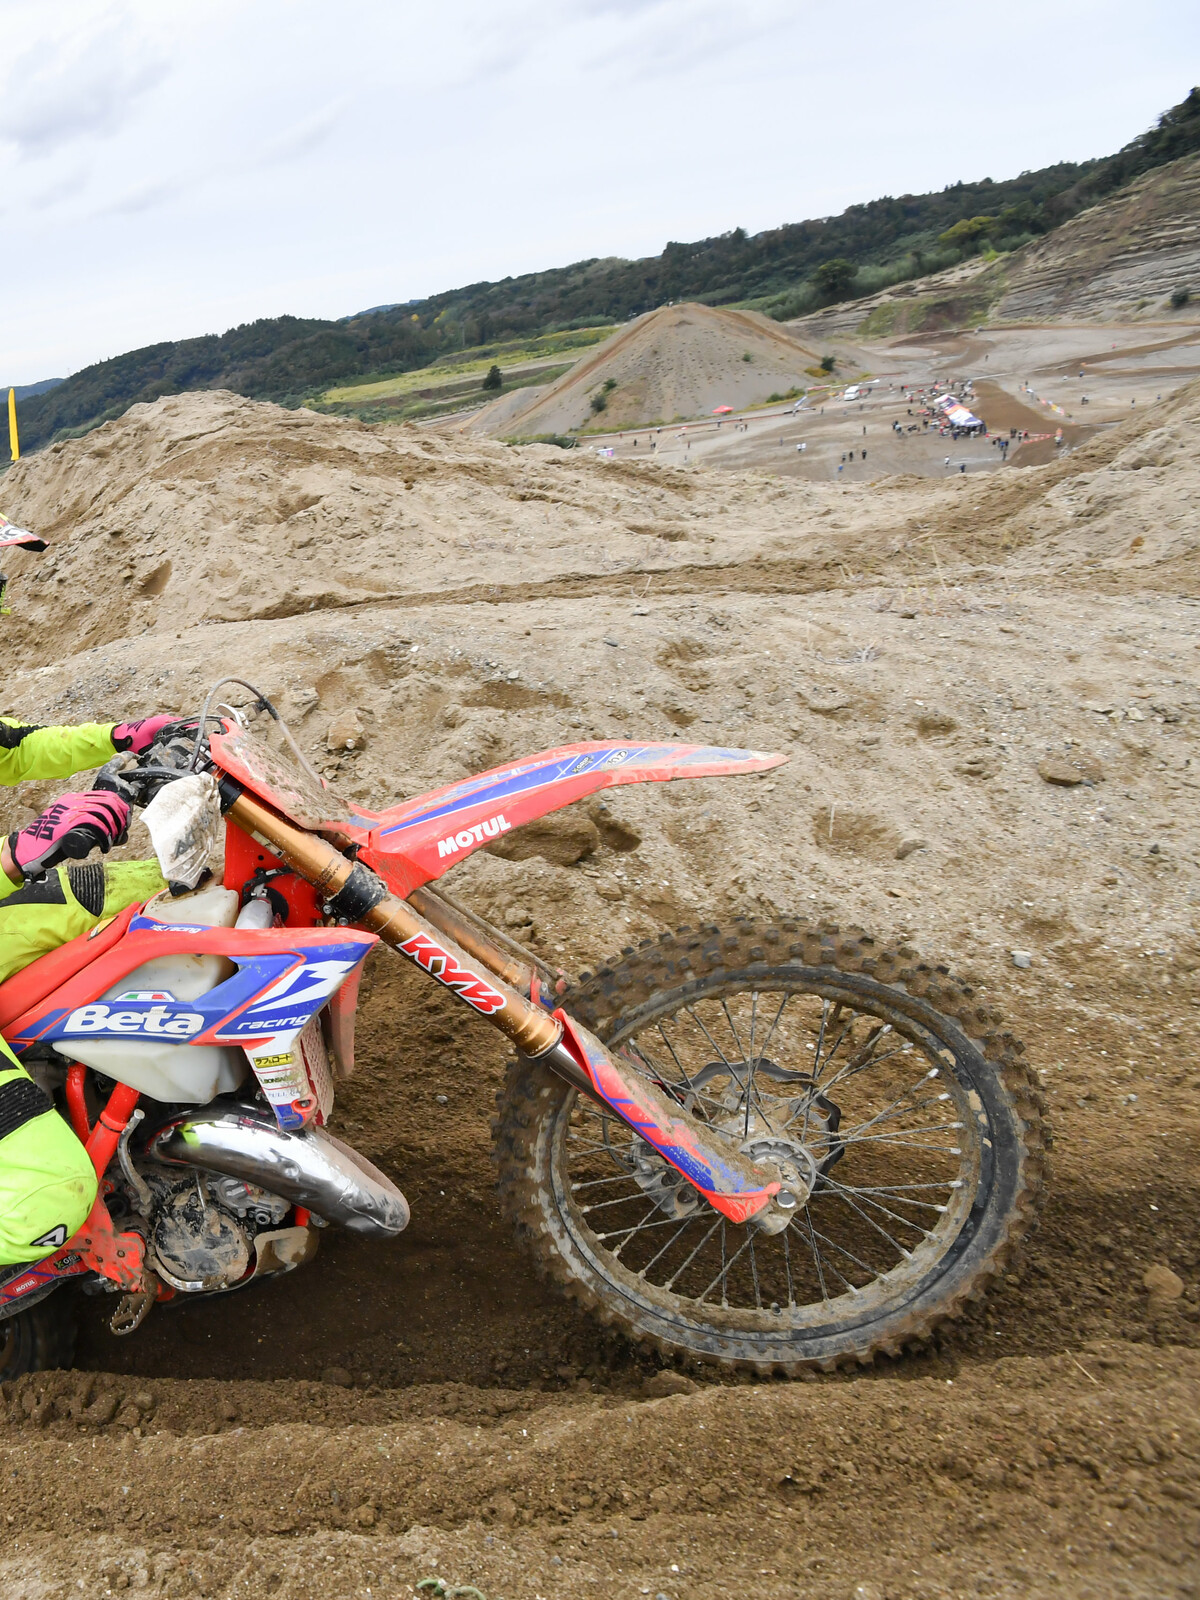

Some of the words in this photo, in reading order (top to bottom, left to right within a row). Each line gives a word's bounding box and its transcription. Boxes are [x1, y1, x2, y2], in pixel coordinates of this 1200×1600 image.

[437, 814, 512, 858] MOTUL
[397, 932, 506, 1014] KYB
[63, 1005, 205, 1034] Beta
[237, 1014, 311, 1030] racing
[15, 1279, 36, 1293] MOTUL
